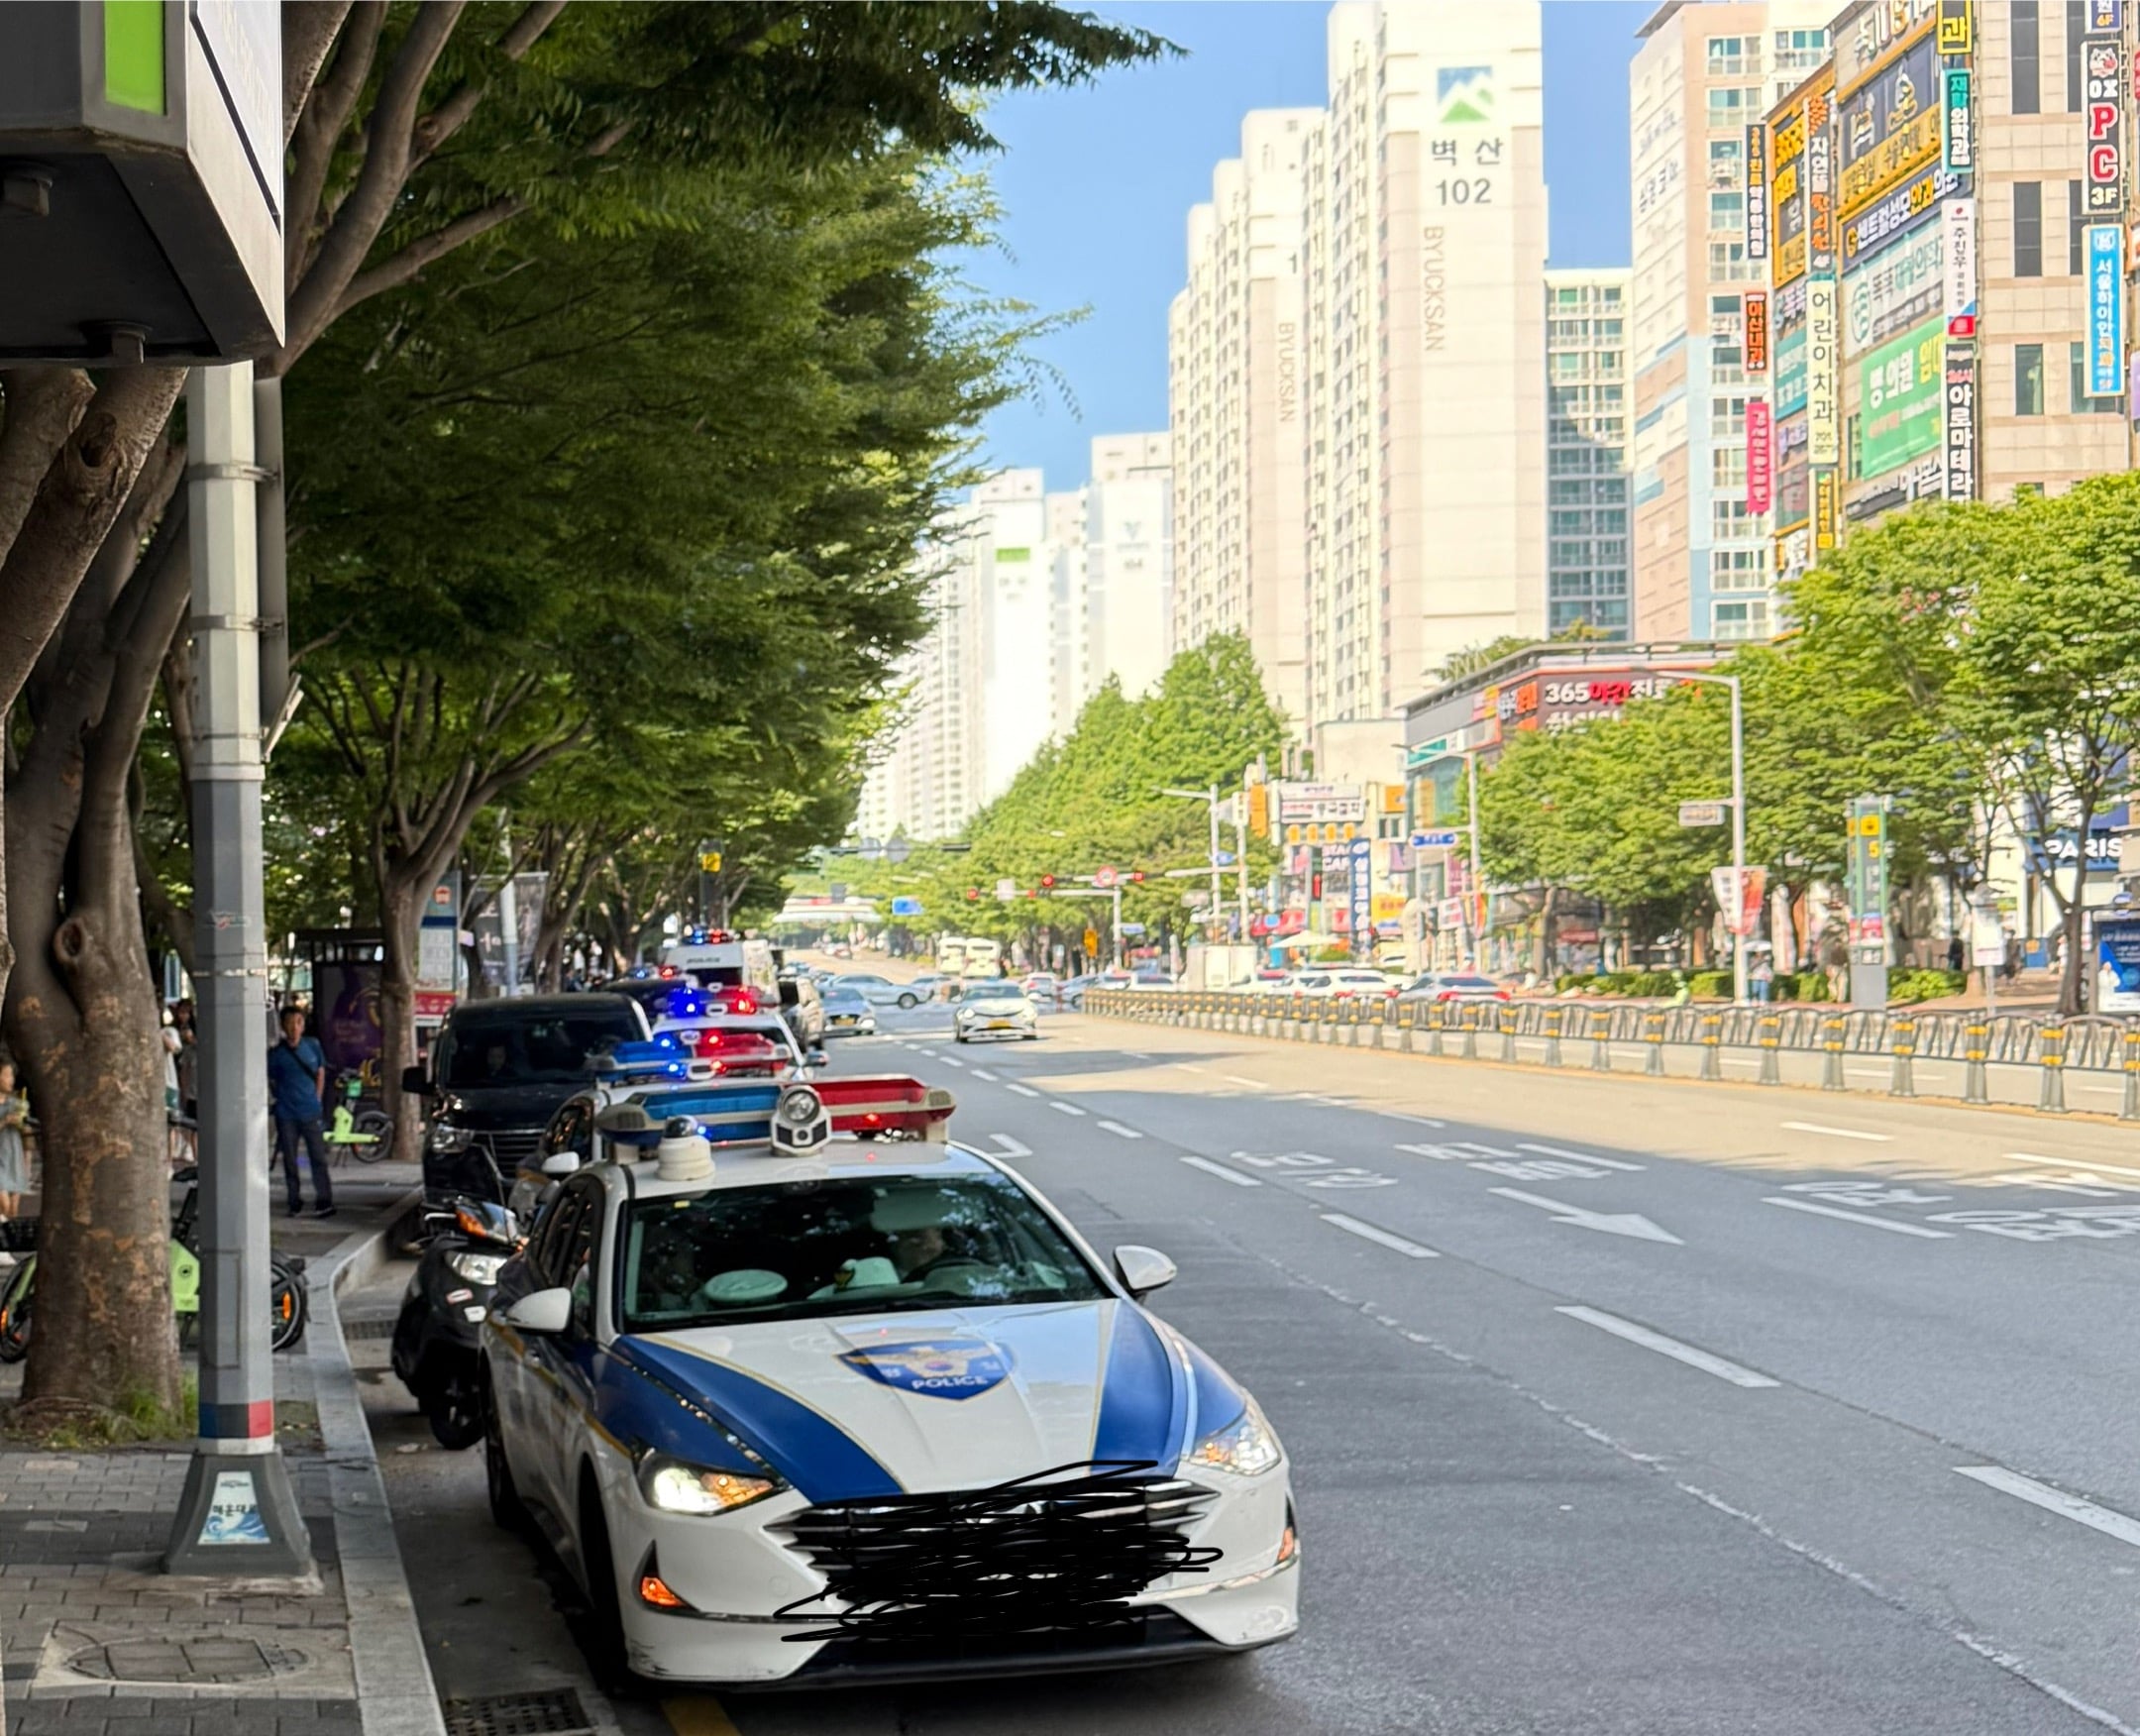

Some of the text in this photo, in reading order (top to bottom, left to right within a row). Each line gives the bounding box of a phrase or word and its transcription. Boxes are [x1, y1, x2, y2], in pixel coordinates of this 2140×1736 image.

[1943, 16, 1966, 42] 과
[2088, 79, 2118, 98] OX
[1432, 137, 1504, 166] 벽산
[2088, 102, 2118, 182] PC
[1436, 177, 1492, 206] 102
[2090, 187, 2118, 206] 3F
[1424, 225, 1445, 352] BYUCKSAN
[1812, 288, 1834, 423] 어린이치과
[1278, 322, 1298, 423] BYUCKSAN
[911, 1375, 989, 1389] POLICE
